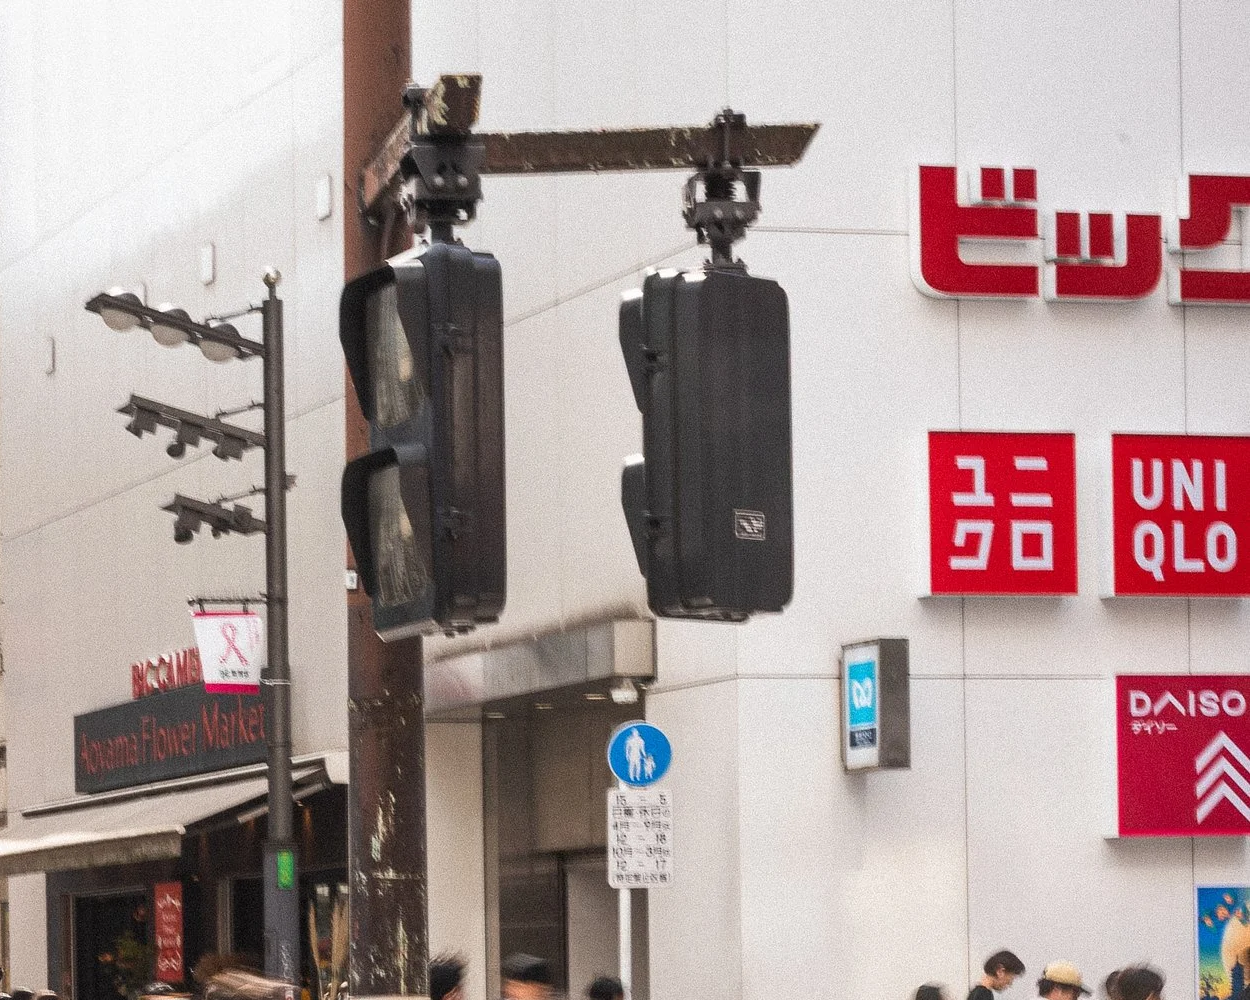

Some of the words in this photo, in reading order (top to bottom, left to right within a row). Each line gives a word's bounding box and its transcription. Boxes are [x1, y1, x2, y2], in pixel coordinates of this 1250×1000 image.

[1130, 456, 1228, 512] UNI
[1131, 518, 1239, 583] QLO
[1129, 689, 1247, 717] DAISO
[141, 715, 197, 765] Flower
